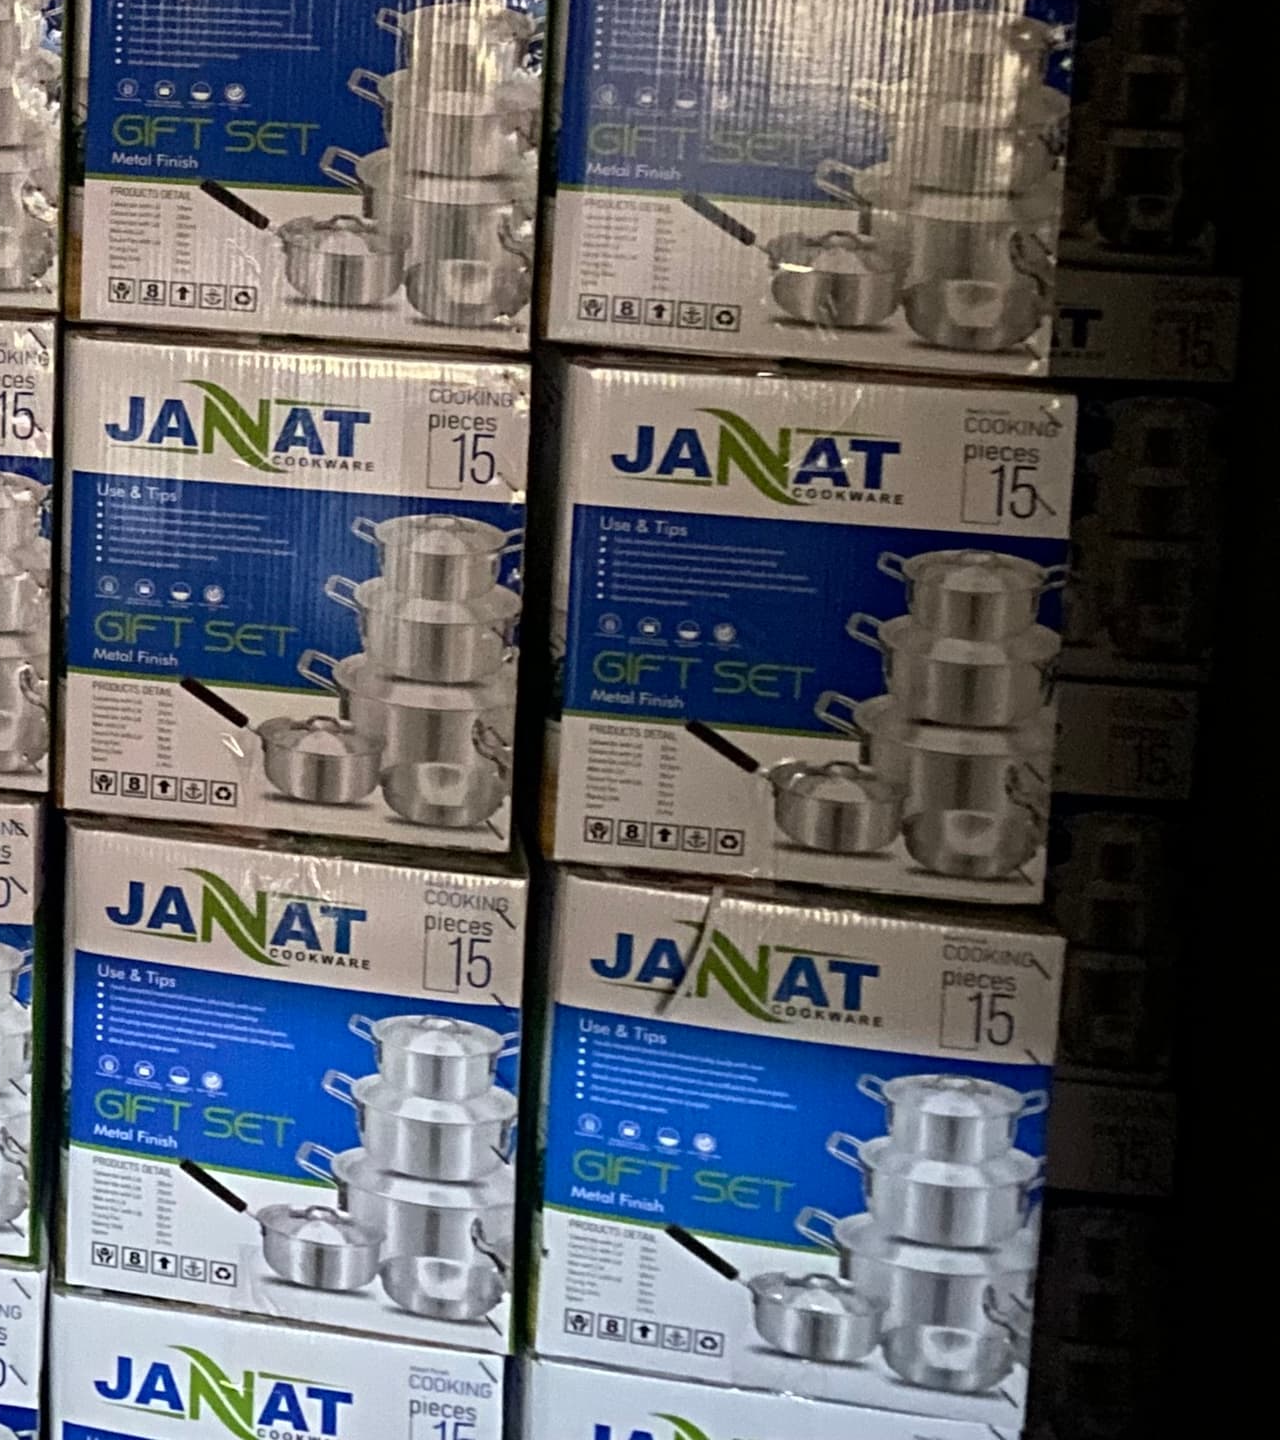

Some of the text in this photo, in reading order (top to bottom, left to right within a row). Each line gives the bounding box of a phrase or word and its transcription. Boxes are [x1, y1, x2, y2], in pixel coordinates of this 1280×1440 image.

[428, 387, 515, 408] COOKING
[428, 411, 497, 434] pieces
[105, 378, 371, 472] JANAT
[272, 455, 374, 472] COOKWARE
[450, 432, 497, 485] 15
[611, 406, 902, 505] JANAT
[964, 441, 1040, 465] pieces
[792, 487, 905, 506] COOKWARE
[987, 463, 1040, 519] 15
[592, 650, 814, 702] GIFT SET
[105, 867, 368, 966] JANAT
[269, 948, 372, 971] COOKWARE
[447, 936, 494, 990] 15
[590, 918, 881, 1022] JANAT
[966, 992, 1019, 1049] 15
[94, 1088, 295, 1148] GIFT SET
[94, 1124, 178, 1149] Metal Finish
[94, 1343, 353, 1440] JANAT
